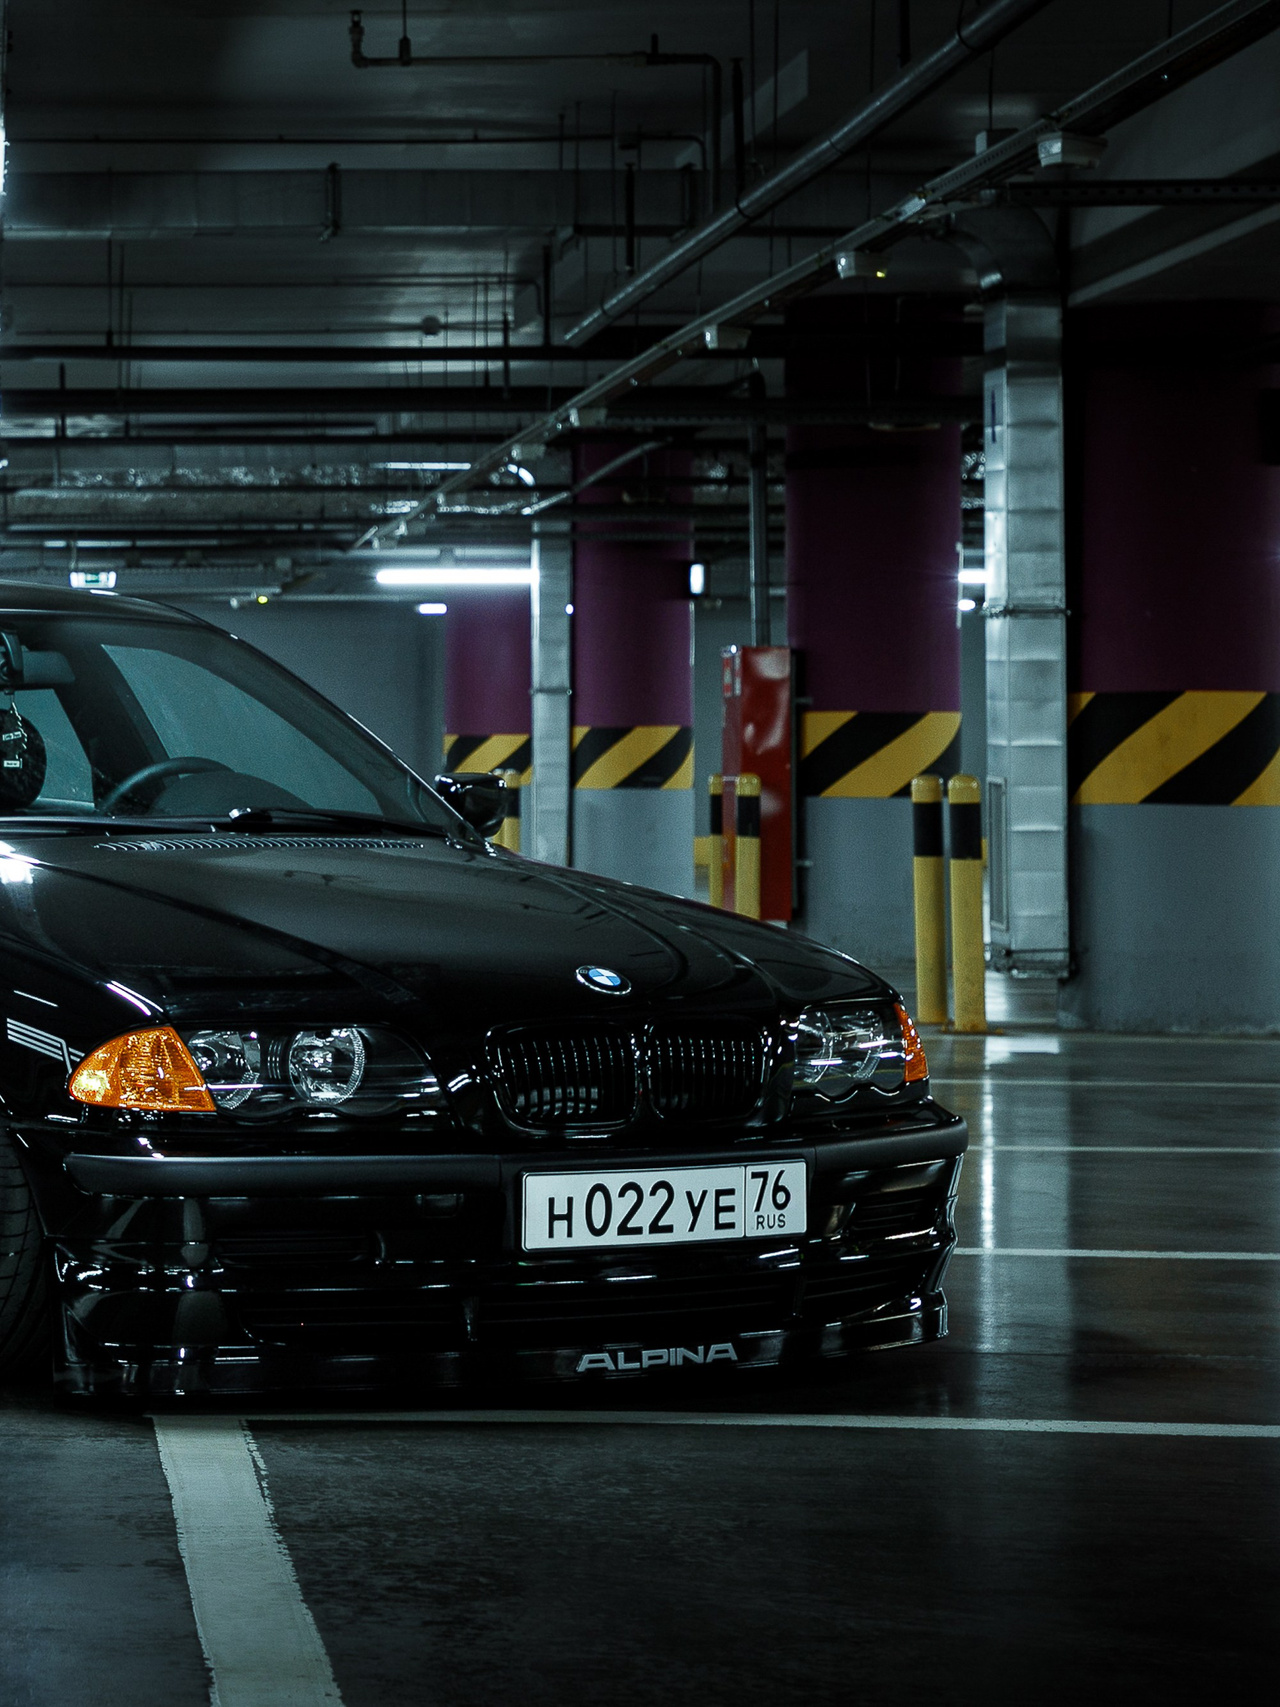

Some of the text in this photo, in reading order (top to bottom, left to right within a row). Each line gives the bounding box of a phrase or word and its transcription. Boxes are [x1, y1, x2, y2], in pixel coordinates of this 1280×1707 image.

[750, 1169, 792, 1213] 76
[756, 1214, 786, 1230] RUS
[576, 1343, 738, 1372] ALPINA
